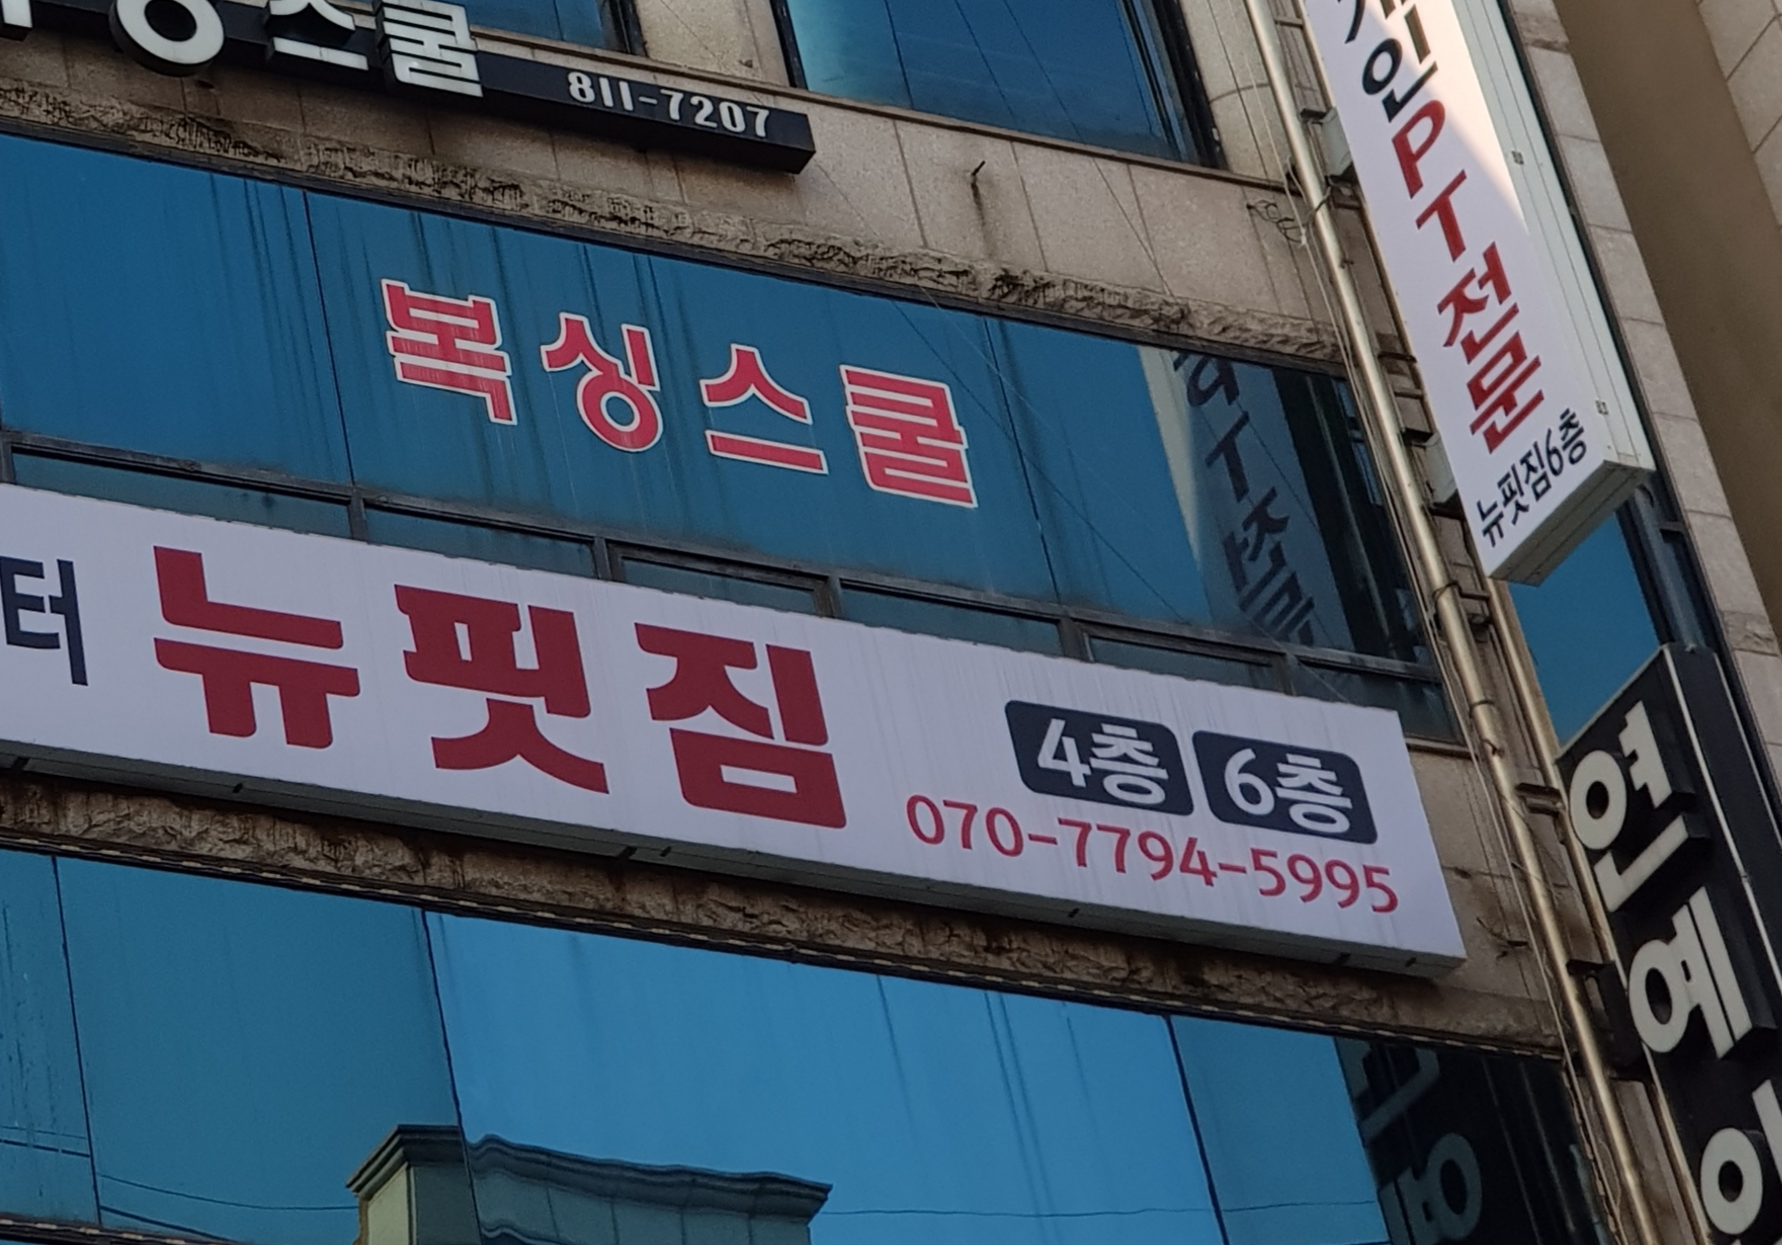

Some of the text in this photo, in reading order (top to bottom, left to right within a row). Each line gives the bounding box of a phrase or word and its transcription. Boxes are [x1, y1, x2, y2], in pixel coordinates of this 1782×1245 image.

[567, 70, 772, 139] 811-7207
[380, 279, 978, 508] 복싱스쿨
[1476, 408, 1587, 548] 뉴핏짐6층
[153, 545, 847, 829] 뉴핏짐
[1036, 717, 1353, 835] 4층 6층
[905, 794, 1399, 914] 070-7794-5995
